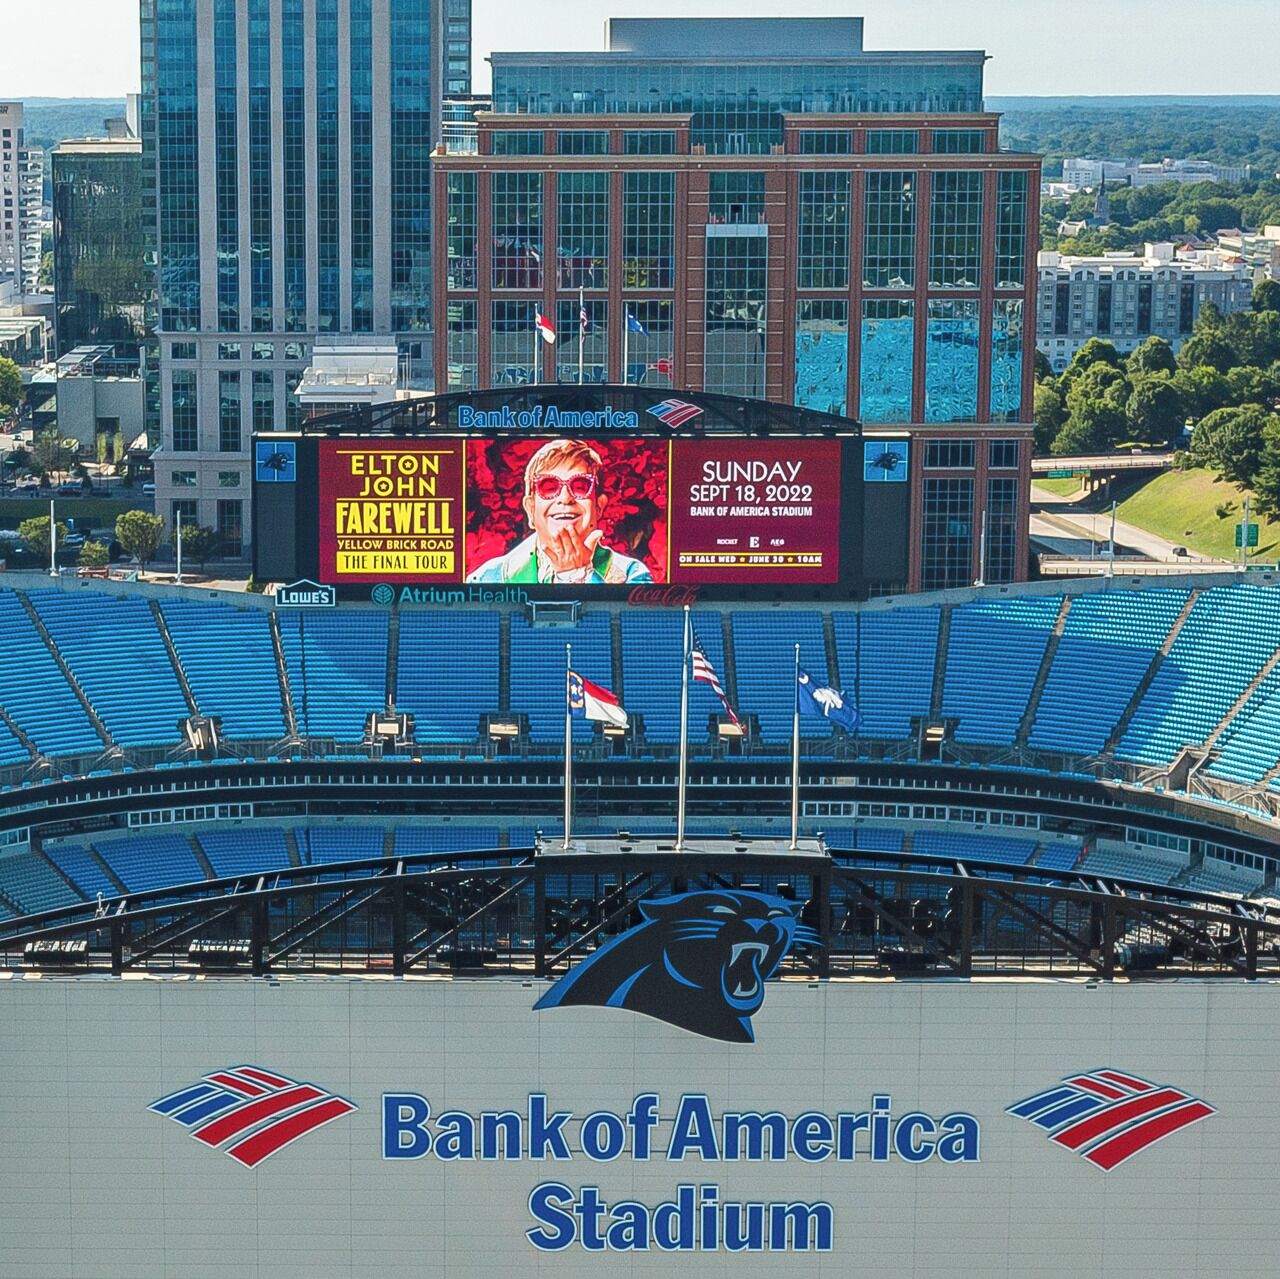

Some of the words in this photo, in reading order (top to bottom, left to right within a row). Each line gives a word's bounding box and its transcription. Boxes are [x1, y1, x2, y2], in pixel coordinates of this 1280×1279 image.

[458, 405, 517, 428] Bank
[518, 405, 543, 428] of
[544, 405, 639, 428] America
[352, 455, 439, 475] ELTON
[703, 461, 802, 482] SUNDAY
[360, 477, 436, 496] JOHN
[690, 485, 730, 502] SEPT
[736, 485, 761, 504] 18,
[766, 485, 812, 502] 2022
[336, 502, 454, 534] FAREWELL
[690, 506, 715, 516] BANK
[717, 506, 729, 516] OF
[730, 506, 769, 516] AMERICA
[772, 506, 812, 516] STADIUM
[338, 540, 383, 550] YELLOW
[386, 540, 417, 550] BRICK
[421, 540, 454, 550] ROAD
[344, 555, 368, 569] THE
[374, 555, 408, 569] FINAL
[416, 555, 447, 569] TOUR
[400, 586, 465, 602] Atrium
[469, 586, 528, 603] Health
[380, 1093, 573, 1162] Bank
[579, 1094, 660, 1162] of
[666, 1094, 982, 1162] America
[526, 1181, 834, 1252] Stadium
